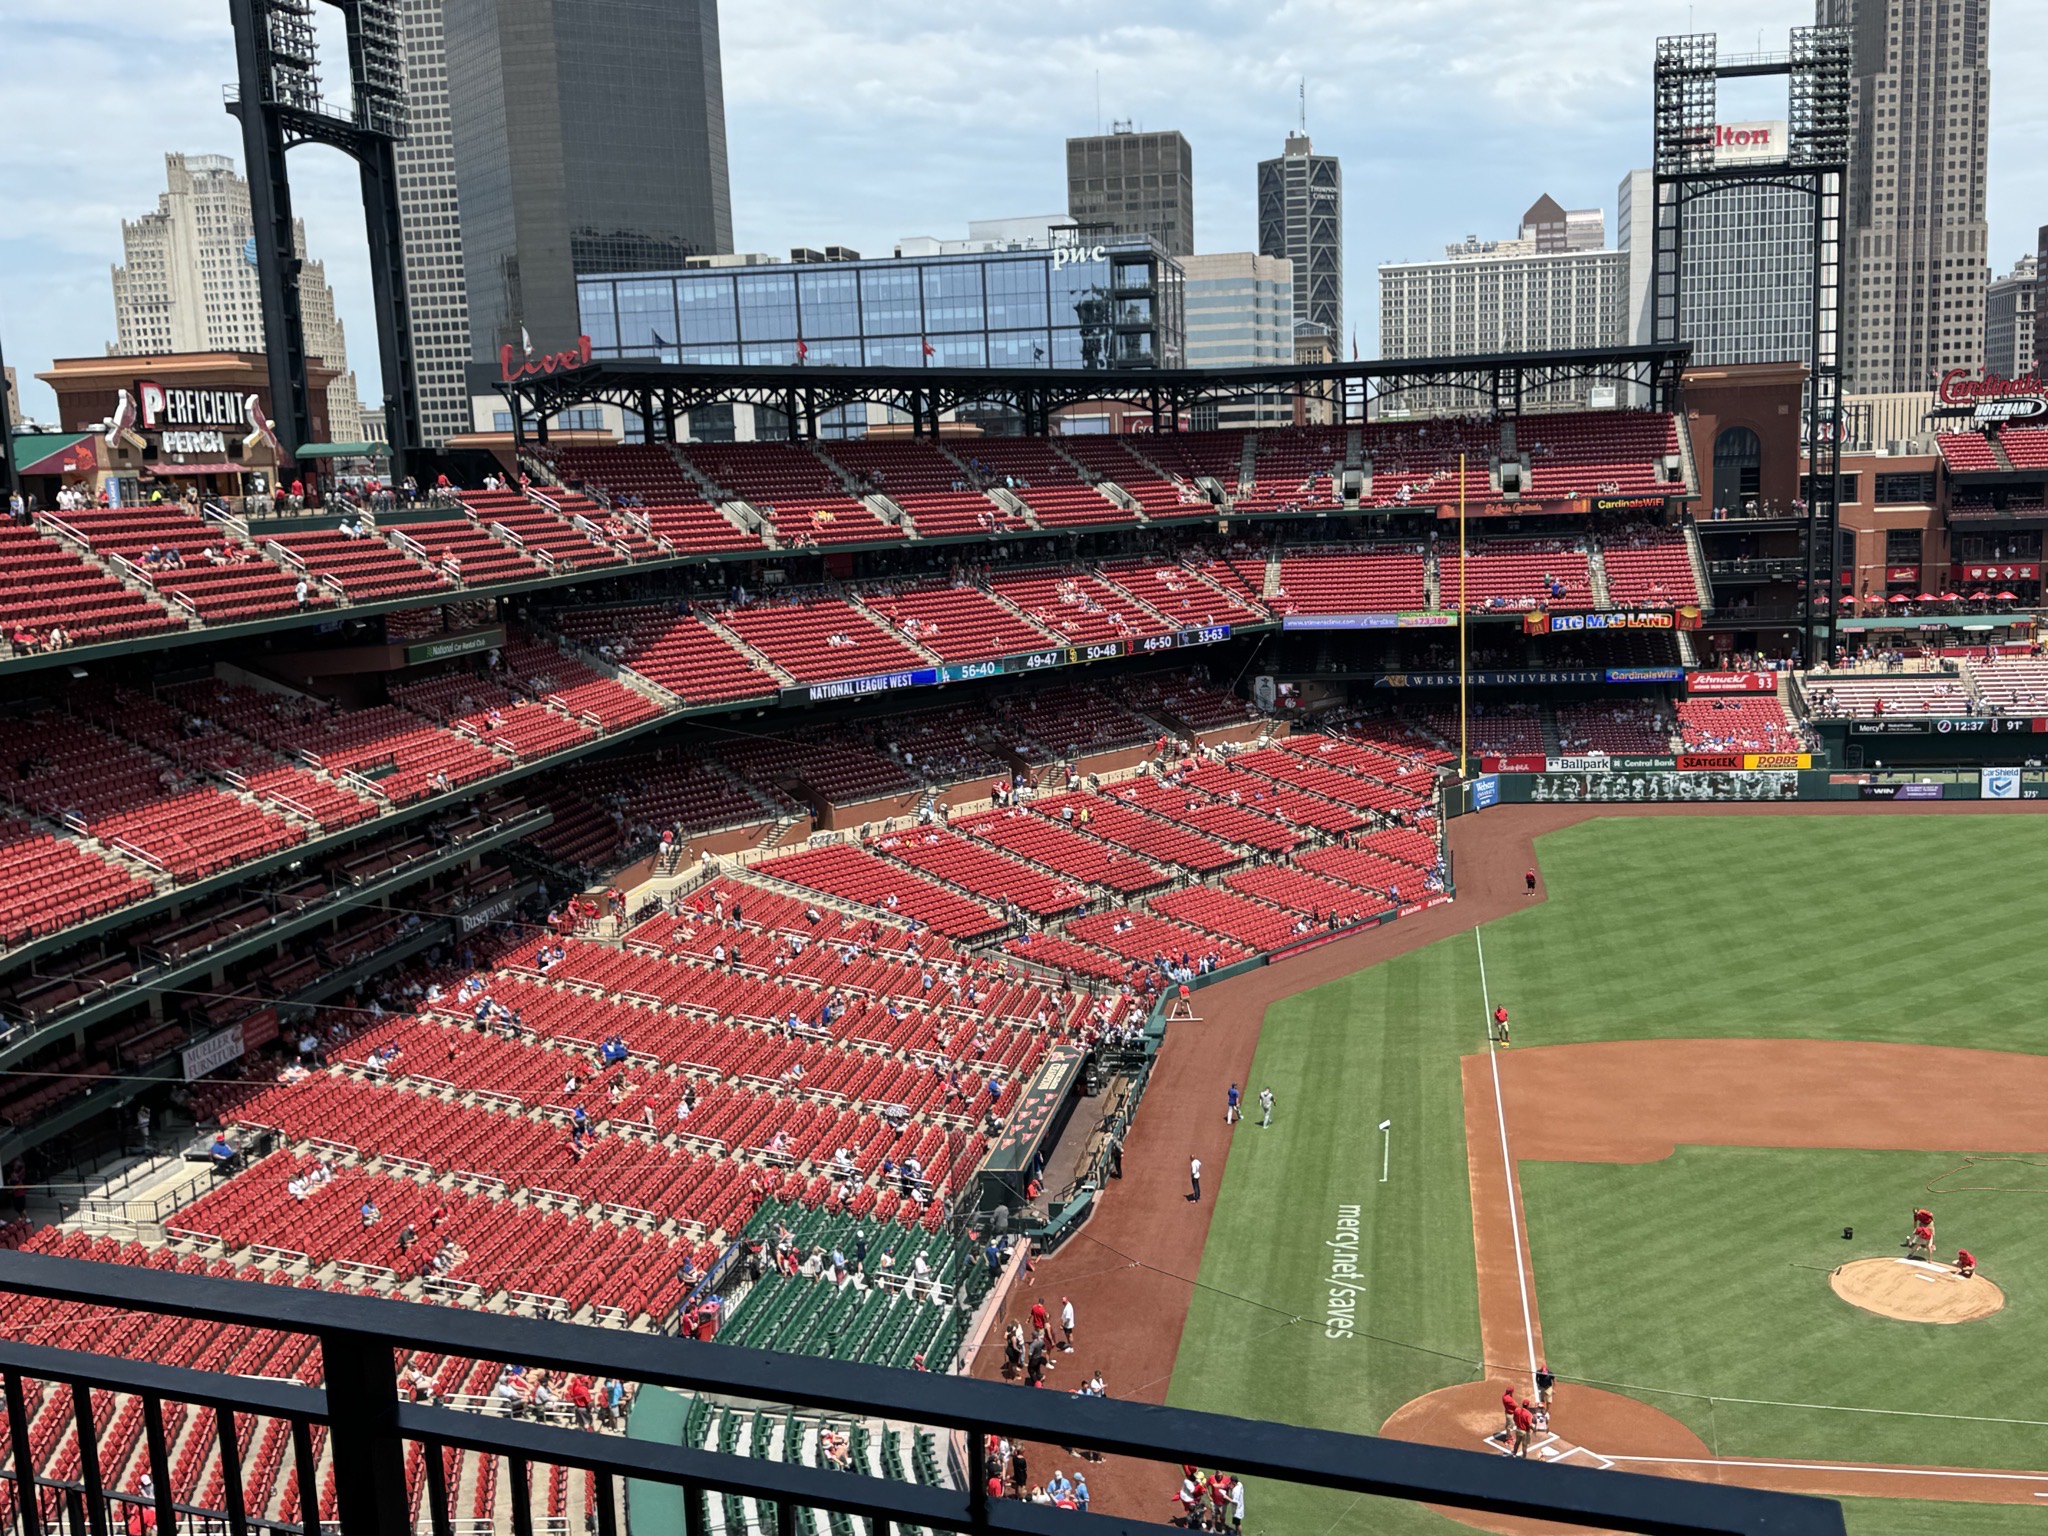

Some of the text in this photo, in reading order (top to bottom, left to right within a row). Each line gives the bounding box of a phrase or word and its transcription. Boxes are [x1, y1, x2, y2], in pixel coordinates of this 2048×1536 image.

[1052, 246, 1106, 271] pwc
[1940, 368, 2044, 404] Cardinals
[140, 382, 245, 428] PERFICIENT
[1974, 402, 2035, 416] HOFFMANN
[162, 431, 226, 453] PERCH
[1552, 613, 1673, 632] BIG MAC LAND
[1143, 635, 1172, 650] 46-50
[1198, 628, 1223, 642] 33-63
[432, 642, 454, 656] National
[1086, 644, 1117, 659] 50-48
[1026, 653, 1058, 668] 49-47
[961, 661, 995, 679] 56-40
[1413, 672, 1599, 685] WEBSTER UNIVERSITY
[1692, 674, 1750, 684] Schnucks
[809, 674, 913, 701] NATIONAL LEAGUE WEST
[1954, 721, 1984, 731] 12:37
[1560, 758, 1609, 770] Ballpark
[1624, 759, 1676, 767] Central Bank
[1683, 756, 1738, 768] SEATGEEK
[1758, 756, 1799, 764] DOBBS
[1983, 768, 2019, 777] CarShield
[188, 1043, 240, 1079] FURNITURE
[1324, 1204, 1366, 1339] mercy.net/saves
